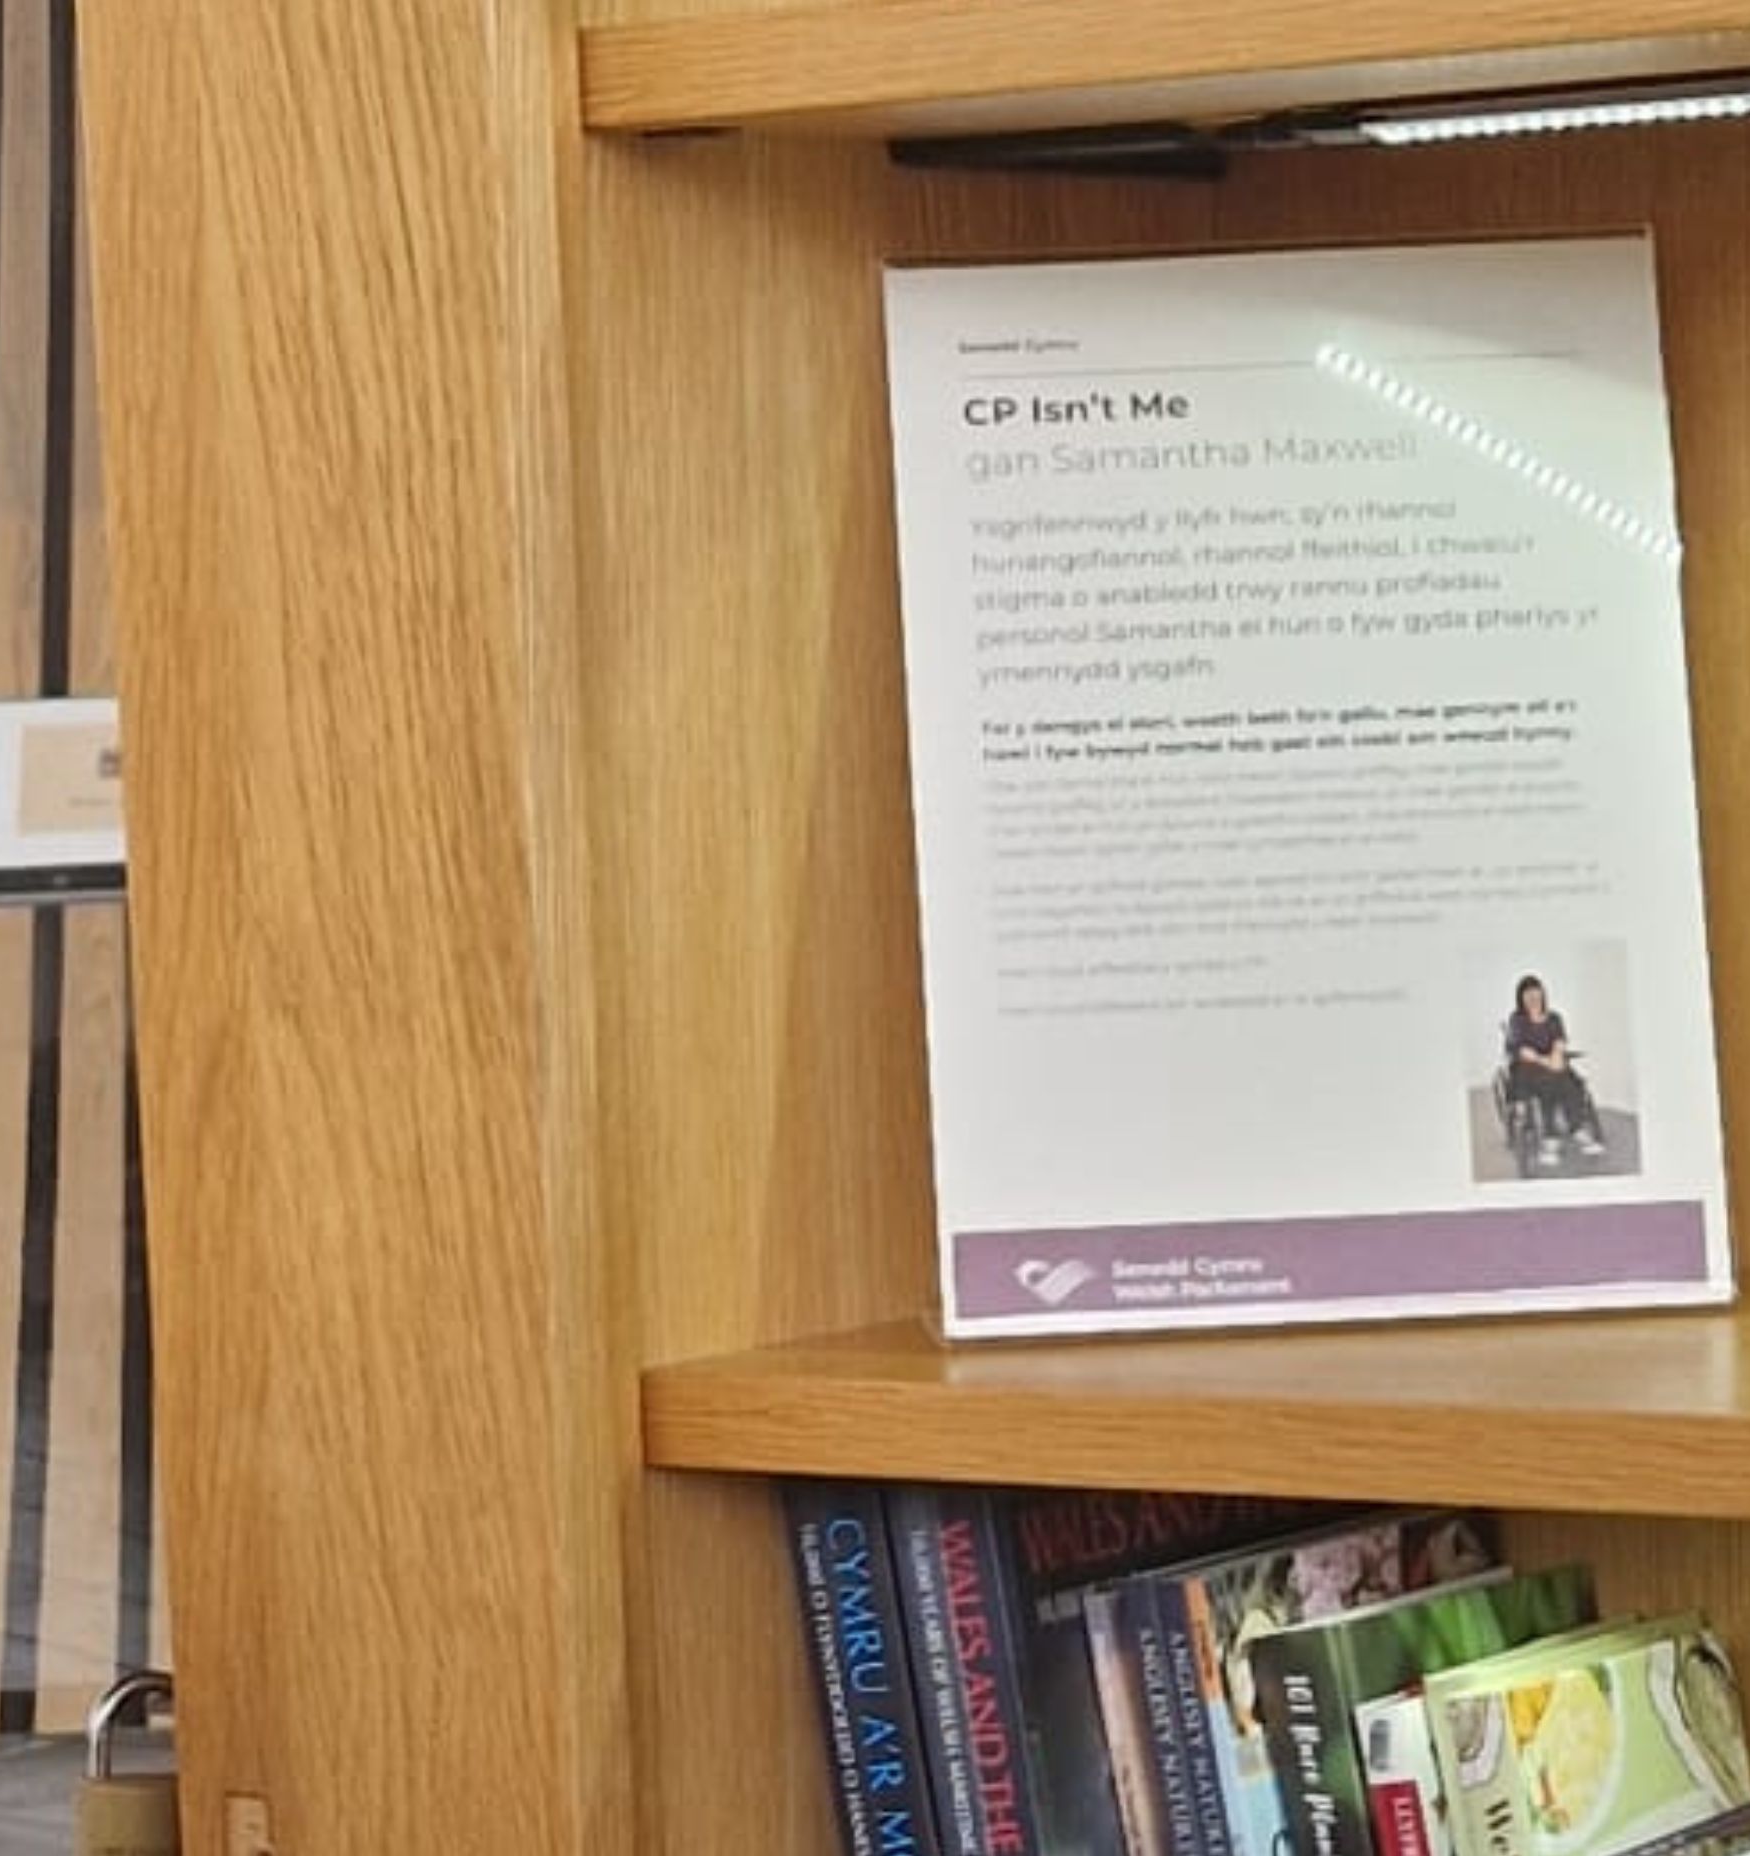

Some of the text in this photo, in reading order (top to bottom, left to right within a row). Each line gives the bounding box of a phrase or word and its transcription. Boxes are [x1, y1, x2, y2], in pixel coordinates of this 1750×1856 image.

[963, 391, 1191, 425] CP Isn't Me
[964, 430, 1417, 482] gan Samantha Maxwell
[824, 1515, 889, 1700] CYMRU
[936, 1518, 991, 1661] WALES
[856, 1711, 905, 1793] A'R
[961, 1665, 1011, 1768] AND
[978, 1776, 1025, 1856] THE
